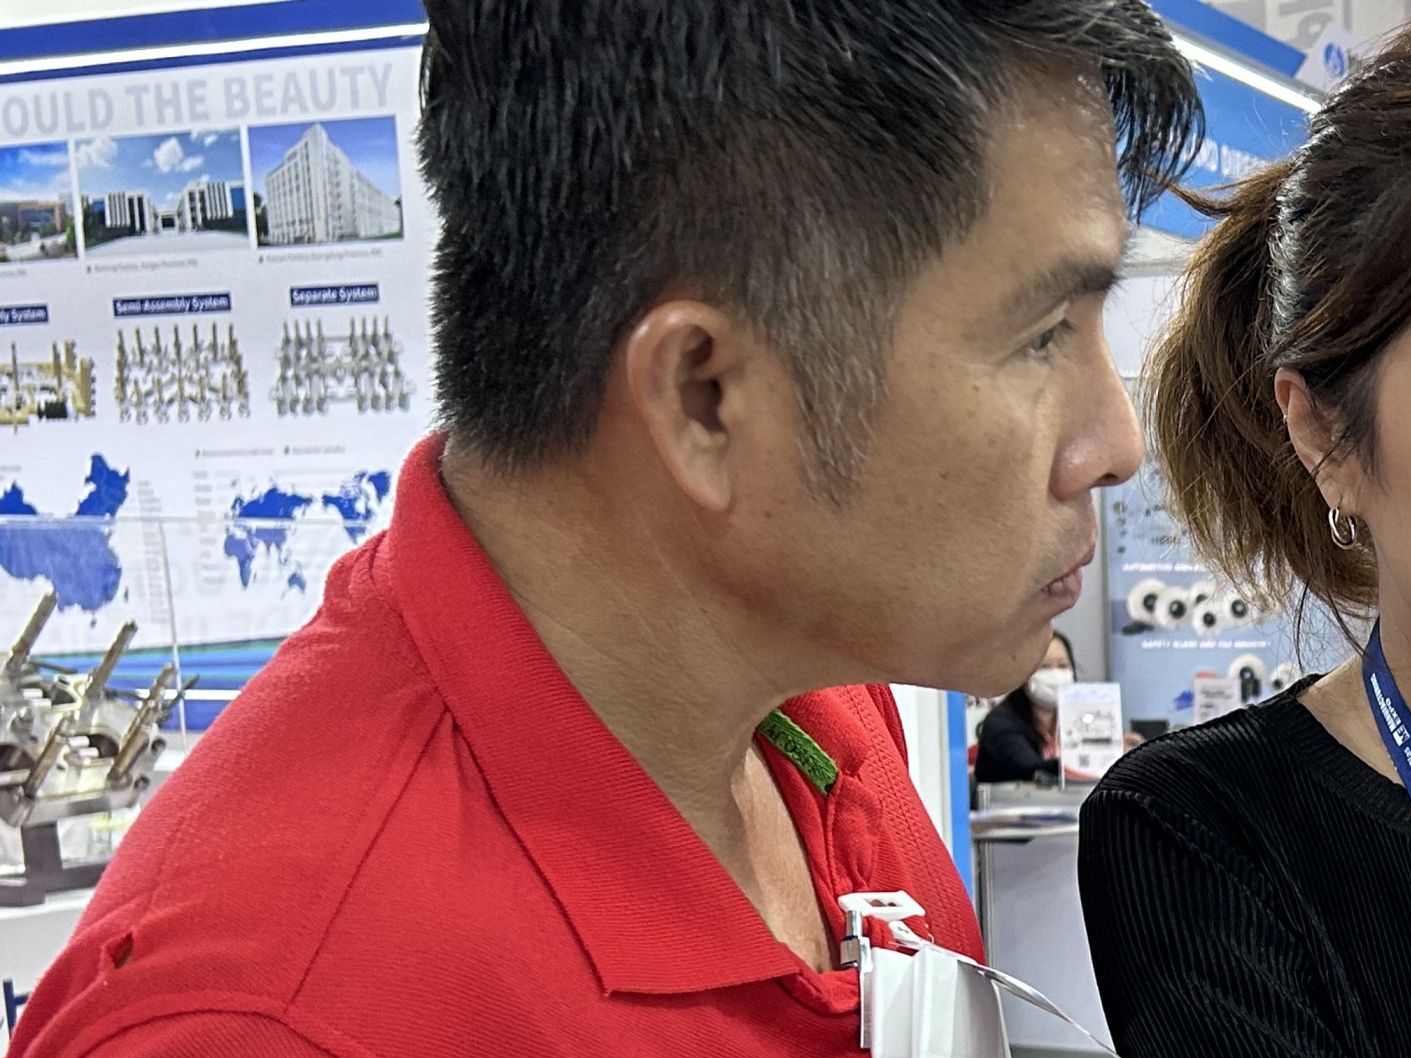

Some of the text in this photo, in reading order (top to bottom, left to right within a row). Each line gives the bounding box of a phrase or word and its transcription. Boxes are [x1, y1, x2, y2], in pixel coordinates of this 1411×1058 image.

[2, 62, 393, 138] OULD THE BEAUTY
[291, 286, 378, 305] Separate System
[143, 297, 190, 314] Assembly
[191, 296, 229, 312] System
[11, 309, 47, 323] System
